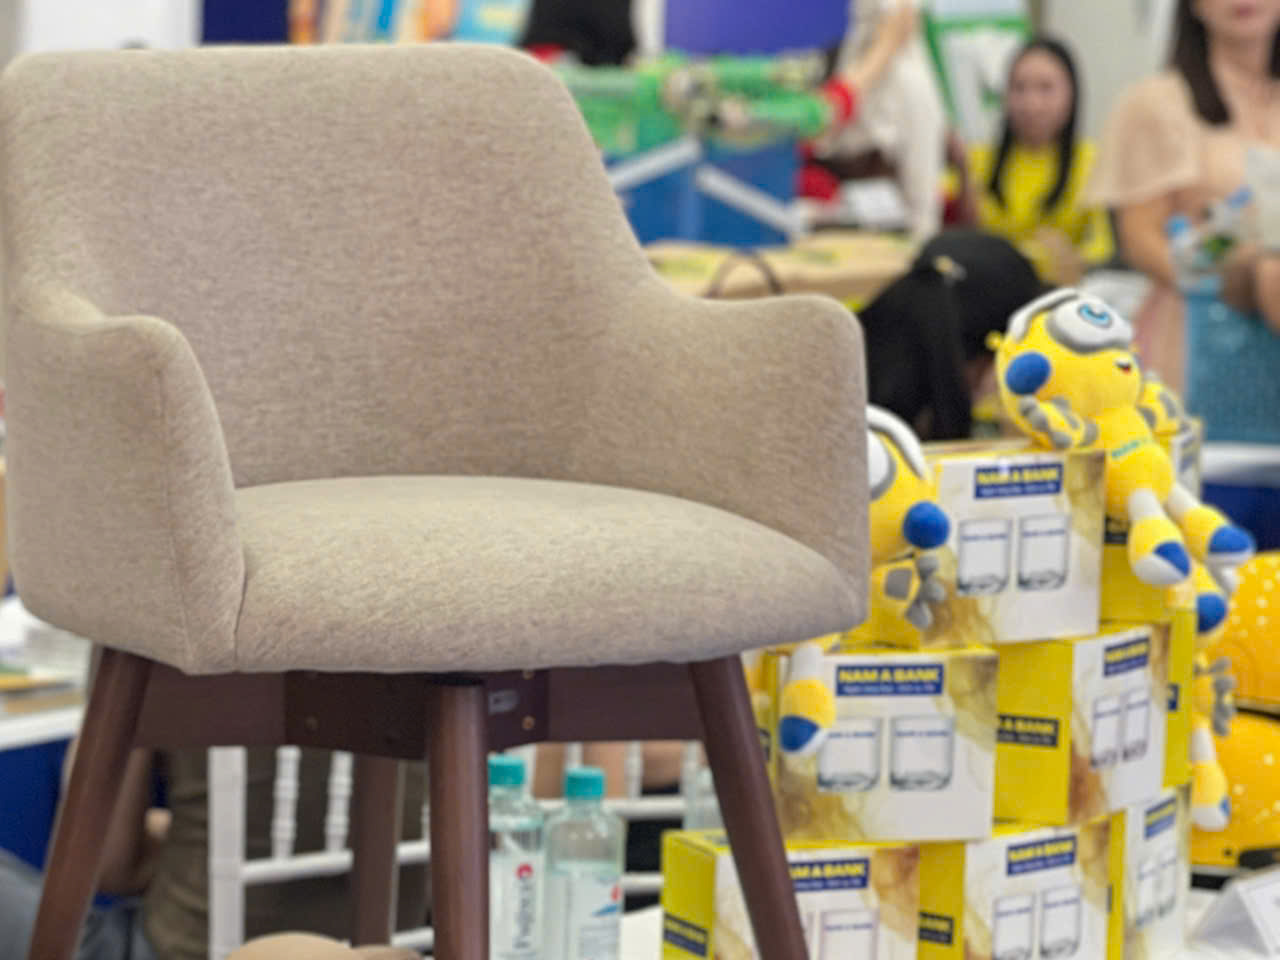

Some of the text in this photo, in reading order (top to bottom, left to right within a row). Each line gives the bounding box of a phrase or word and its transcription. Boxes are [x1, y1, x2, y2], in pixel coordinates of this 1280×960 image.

[1023, 467, 1058, 481] BANK
[839, 668, 939, 683] NAM A BANK
[1016, 720, 1056, 735] BANK
[789, 862, 865, 880] AM A BANK
